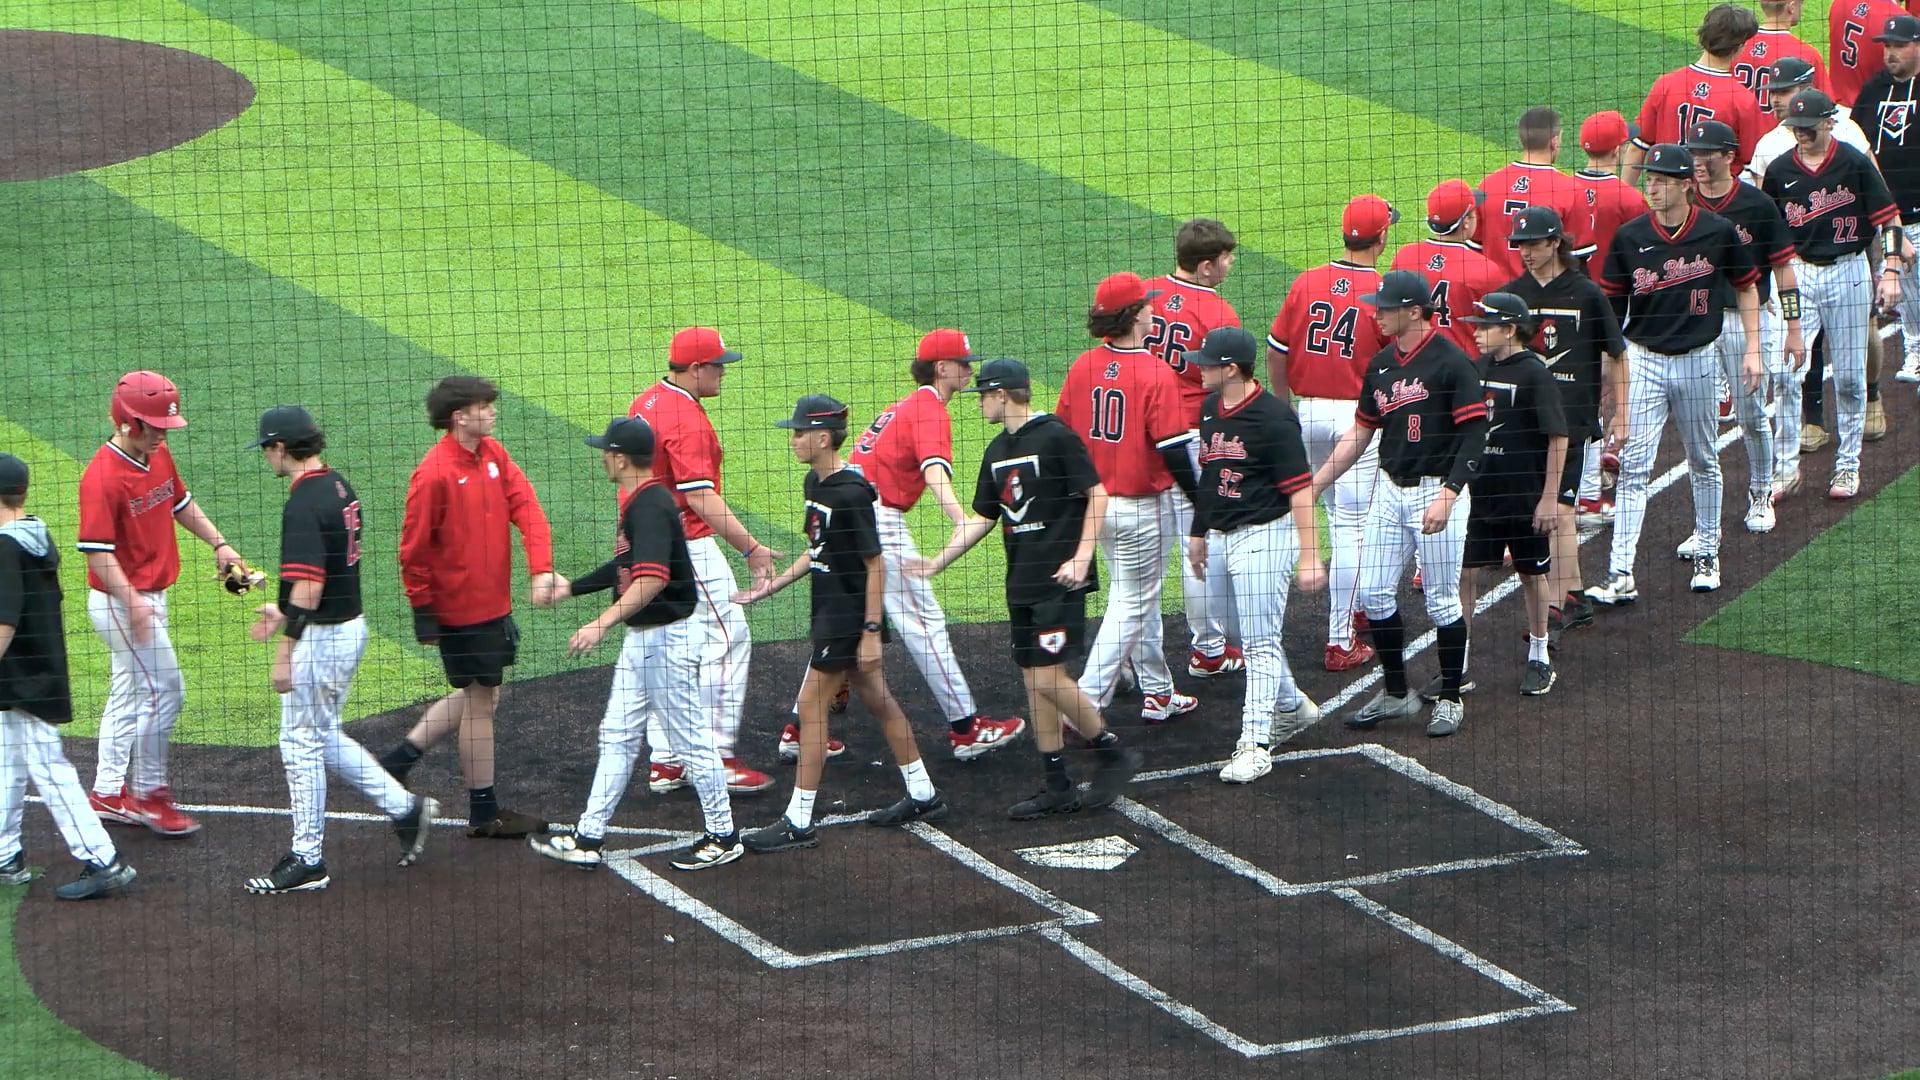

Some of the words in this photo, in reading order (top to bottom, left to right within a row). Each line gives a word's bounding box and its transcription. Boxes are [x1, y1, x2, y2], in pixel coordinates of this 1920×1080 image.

[1840, 20, 1864, 68] 5
[1809, 184, 1855, 211] Blacks
[1832, 216, 1859, 244] 22
[1663, 254, 1714, 280] Blacks
[1689, 288, 1709, 316] 13
[1142, 314, 1192, 375] 26
[1306, 301, 1360, 359] 24
[1089, 386, 1126, 443] 10
[1407, 414, 1421, 442] 8
[1217, 468, 1244, 498] 32
